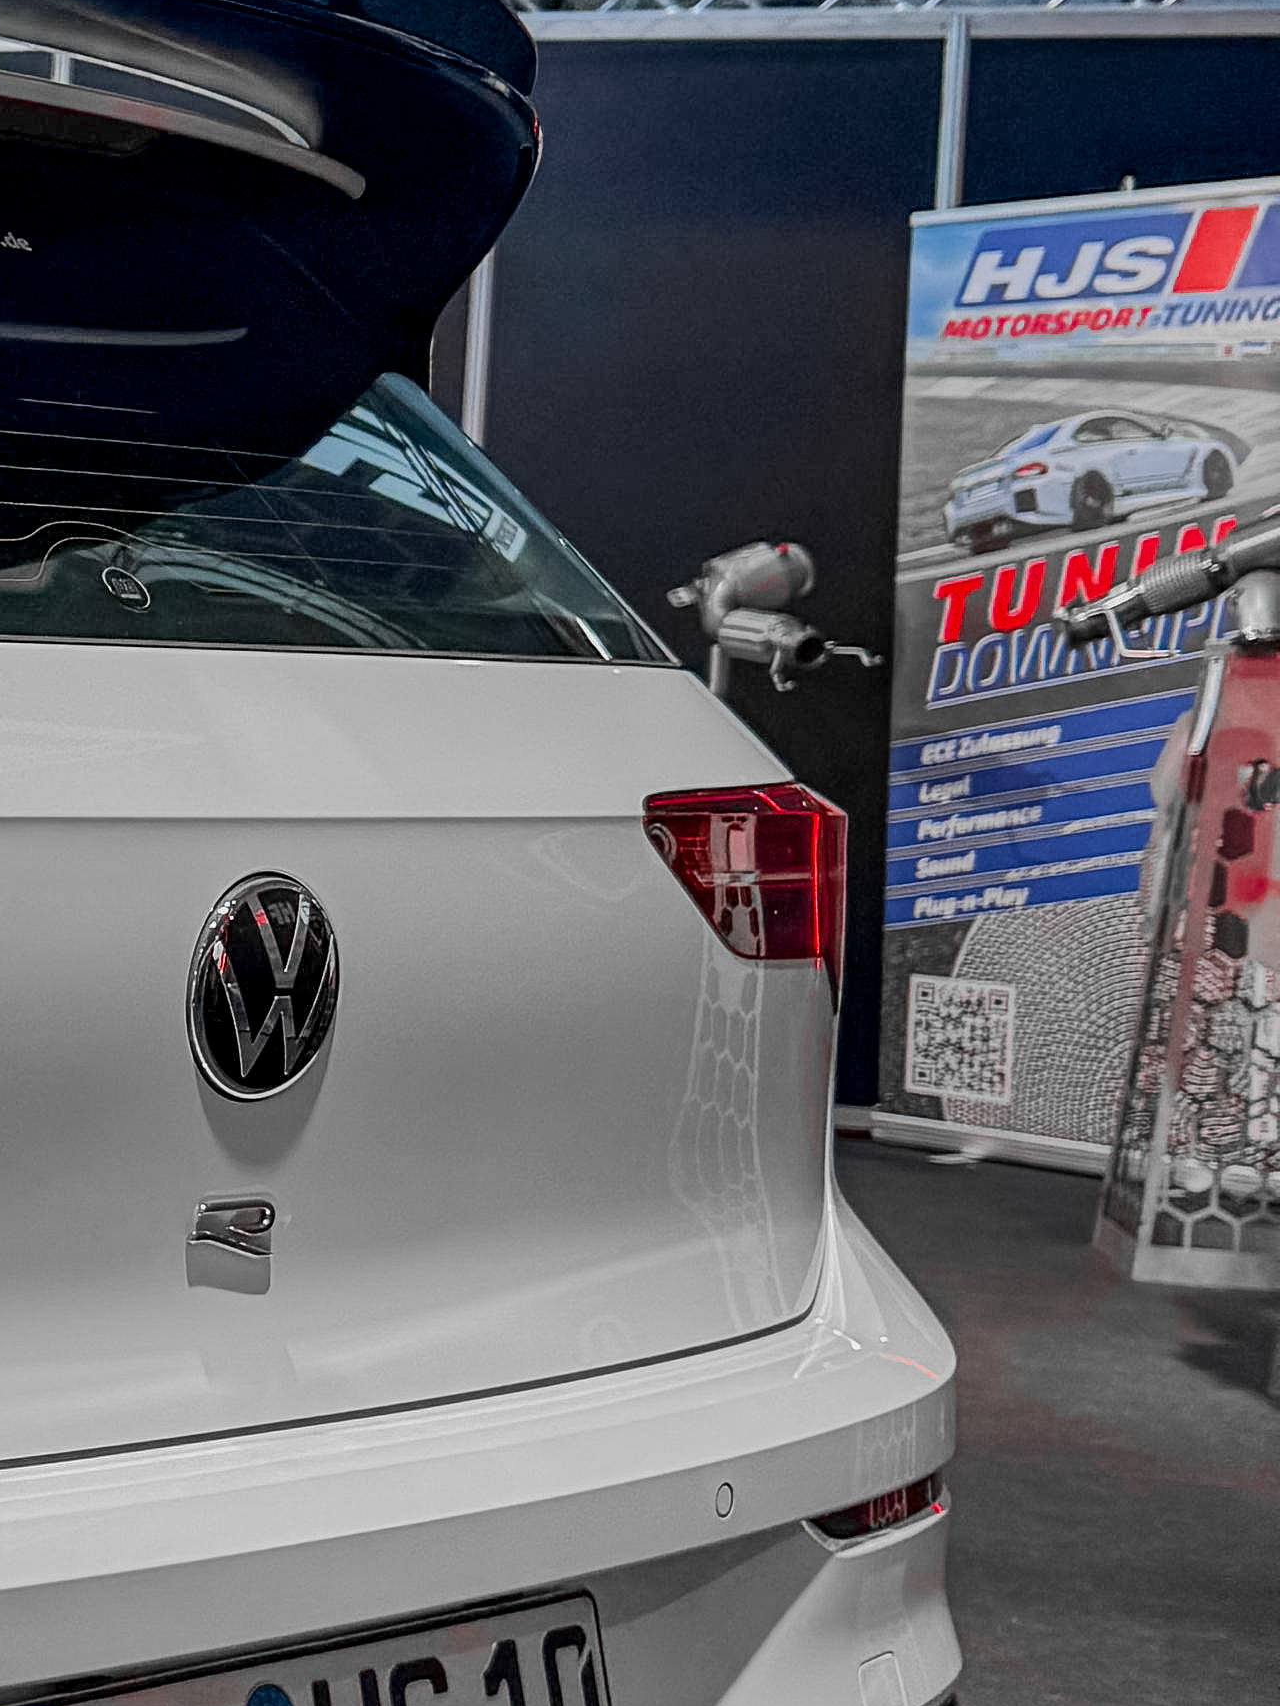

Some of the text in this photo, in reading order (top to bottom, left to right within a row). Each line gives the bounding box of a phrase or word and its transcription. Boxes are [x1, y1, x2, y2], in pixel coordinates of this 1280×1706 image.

[960, 236, 1176, 305] HJS
[942, 306, 1153, 341] MOTORSPORT
[1162, 296, 1280, 328] TUNING
[918, 774, 971, 805] Legal
[917, 805, 1043, 841] Performance
[915, 850, 976, 880] Sound
[913, 886, 1030, 919] Plug-n-Play
